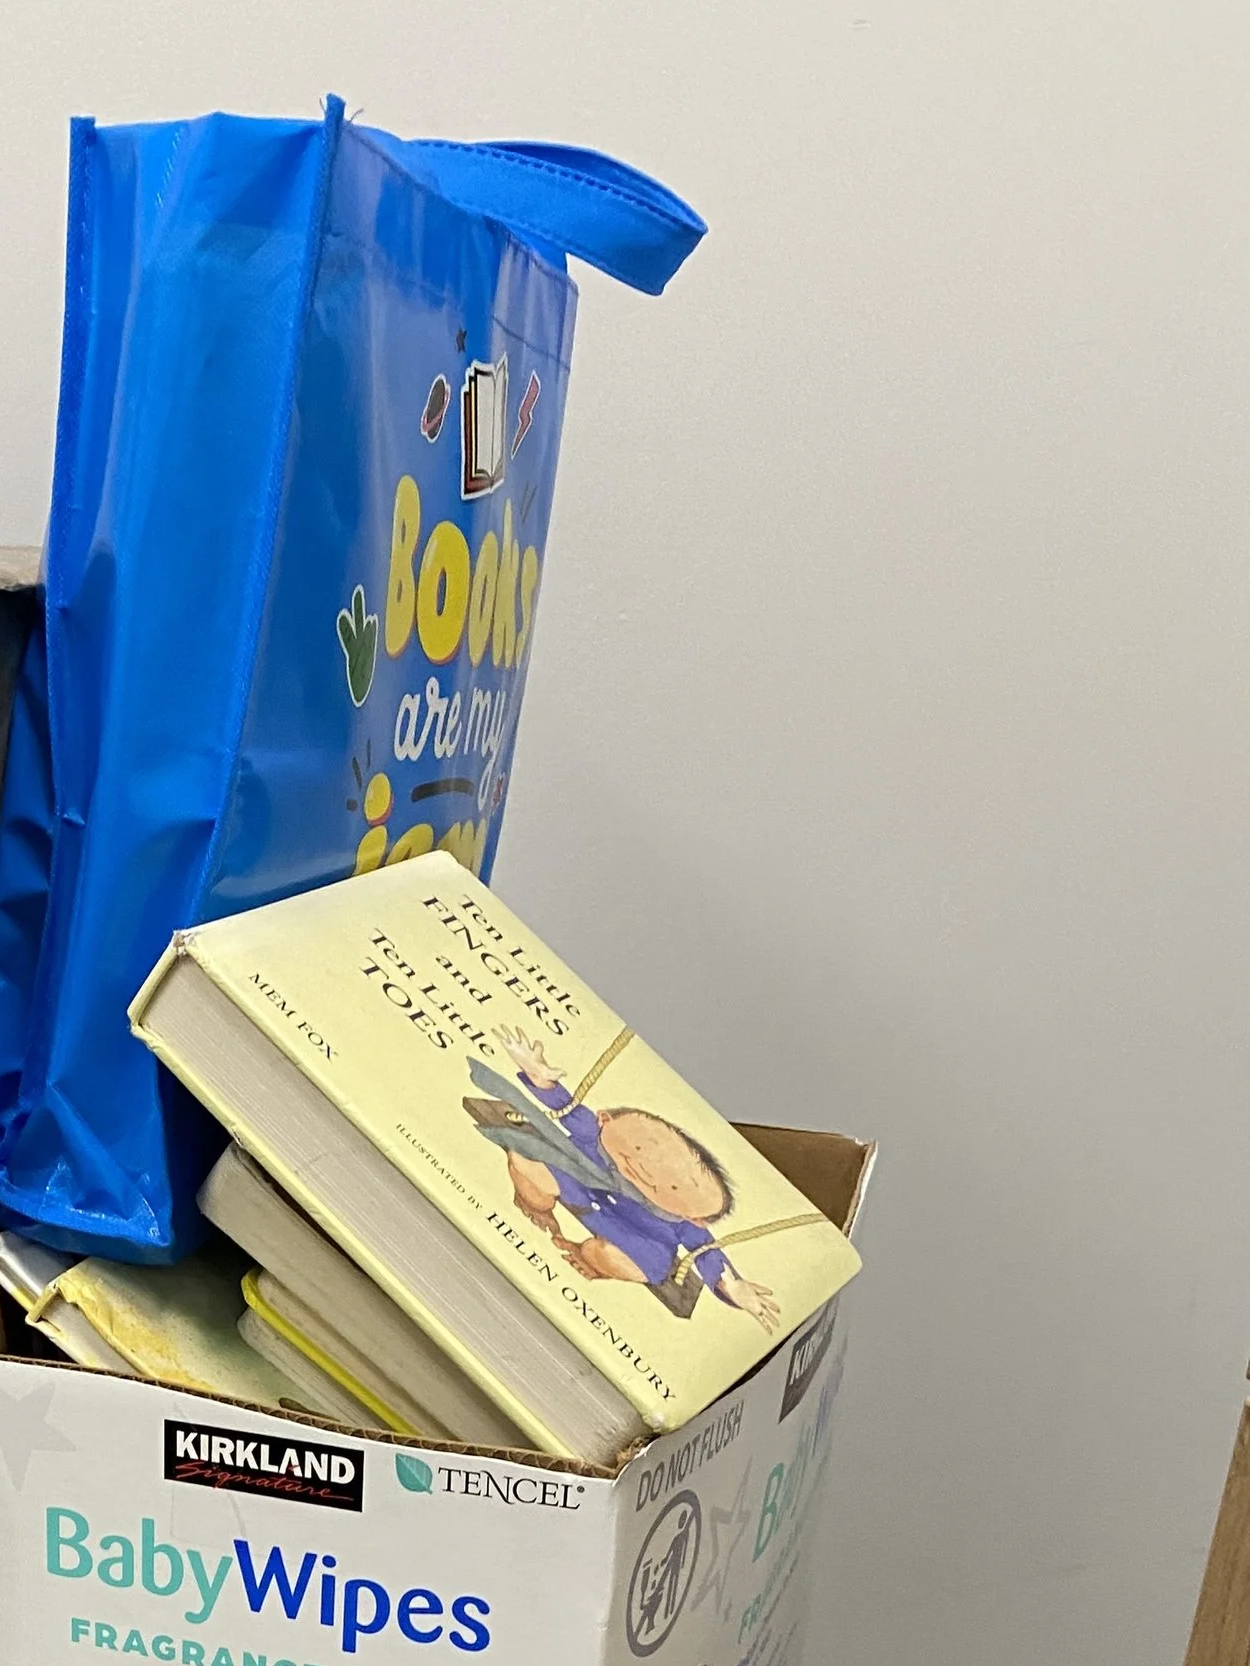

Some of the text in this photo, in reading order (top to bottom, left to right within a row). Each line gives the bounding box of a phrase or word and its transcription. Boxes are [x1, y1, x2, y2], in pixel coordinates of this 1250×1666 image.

[385, 474, 538, 670] Books
[393, 676, 510, 811] are my
[359, 956, 453, 1049] TOES
[369, 928, 495, 1057] Ten Little
[421, 895, 569, 1036] FINGERS
[435, 954, 492, 1005] and
[461, 894, 581, 1017] Ten Little
[248, 972, 340, 1064] MEM FOX
[395, 1123, 483, 1211] ILLUSTRATED BY
[486, 1210, 677, 1402] HELEN OXENBURY
[174, 1461, 355, 1501] Signature
[175, 1430, 355, 1484] KIRKLAND
[636, 1399, 744, 1512] DO NOT FLUSH
